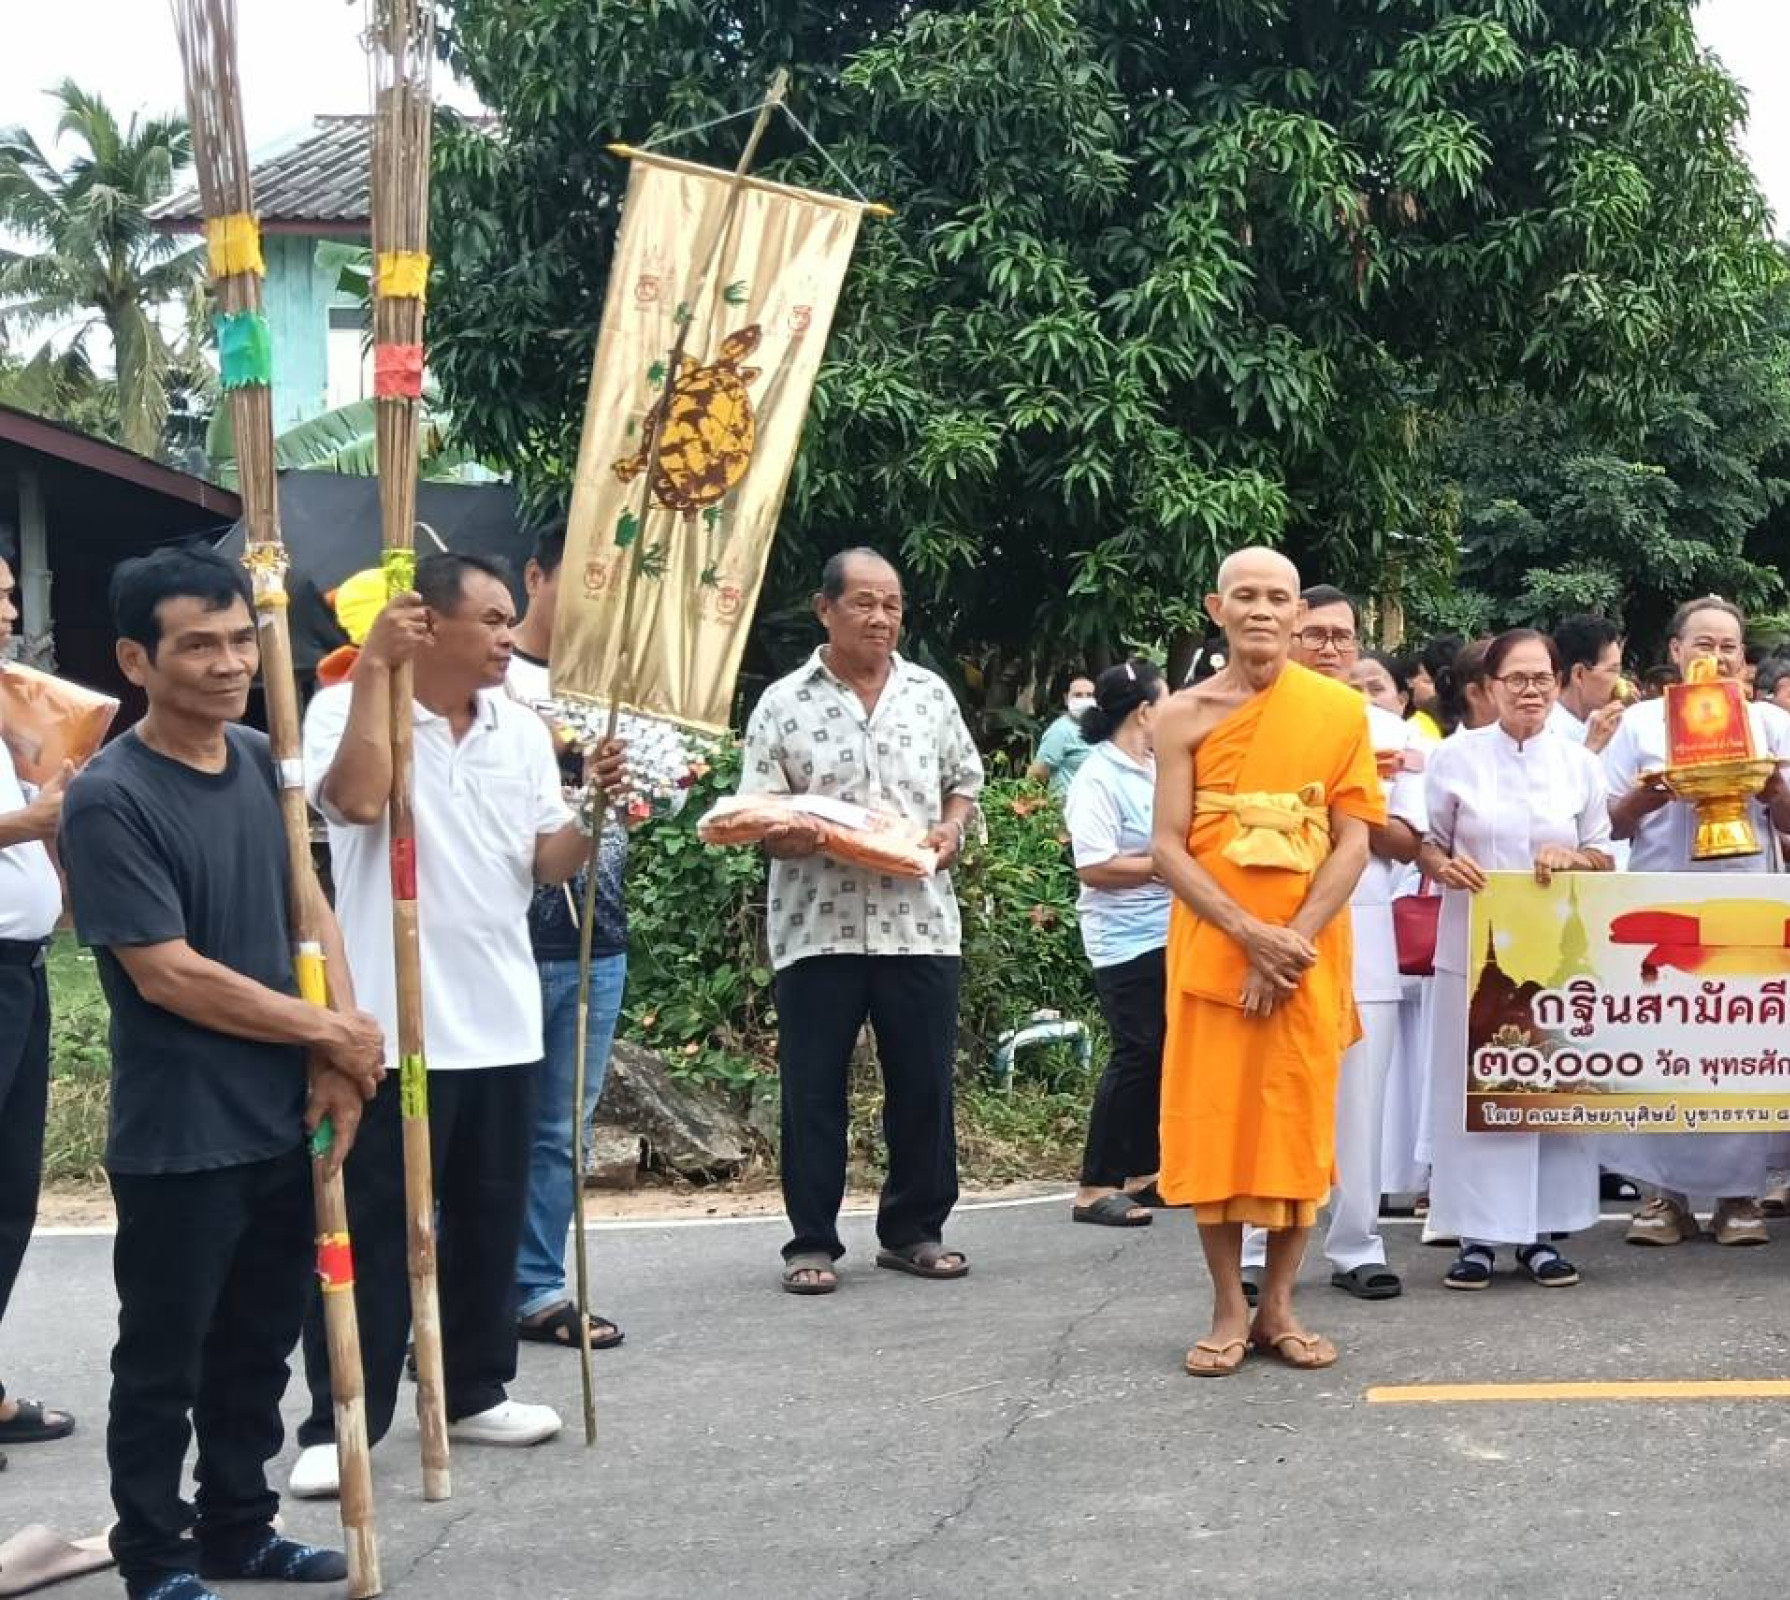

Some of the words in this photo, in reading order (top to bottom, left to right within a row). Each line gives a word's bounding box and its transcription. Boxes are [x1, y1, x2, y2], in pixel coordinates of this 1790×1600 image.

[1655, 1048, 1691, 1077] วัด
[1482, 1103, 1521, 1123] โดย
[1527, 1103, 1677, 1128] คณะศิษยานุศิษย์
[1683, 1105, 1770, 1128] บูชาธรรม
